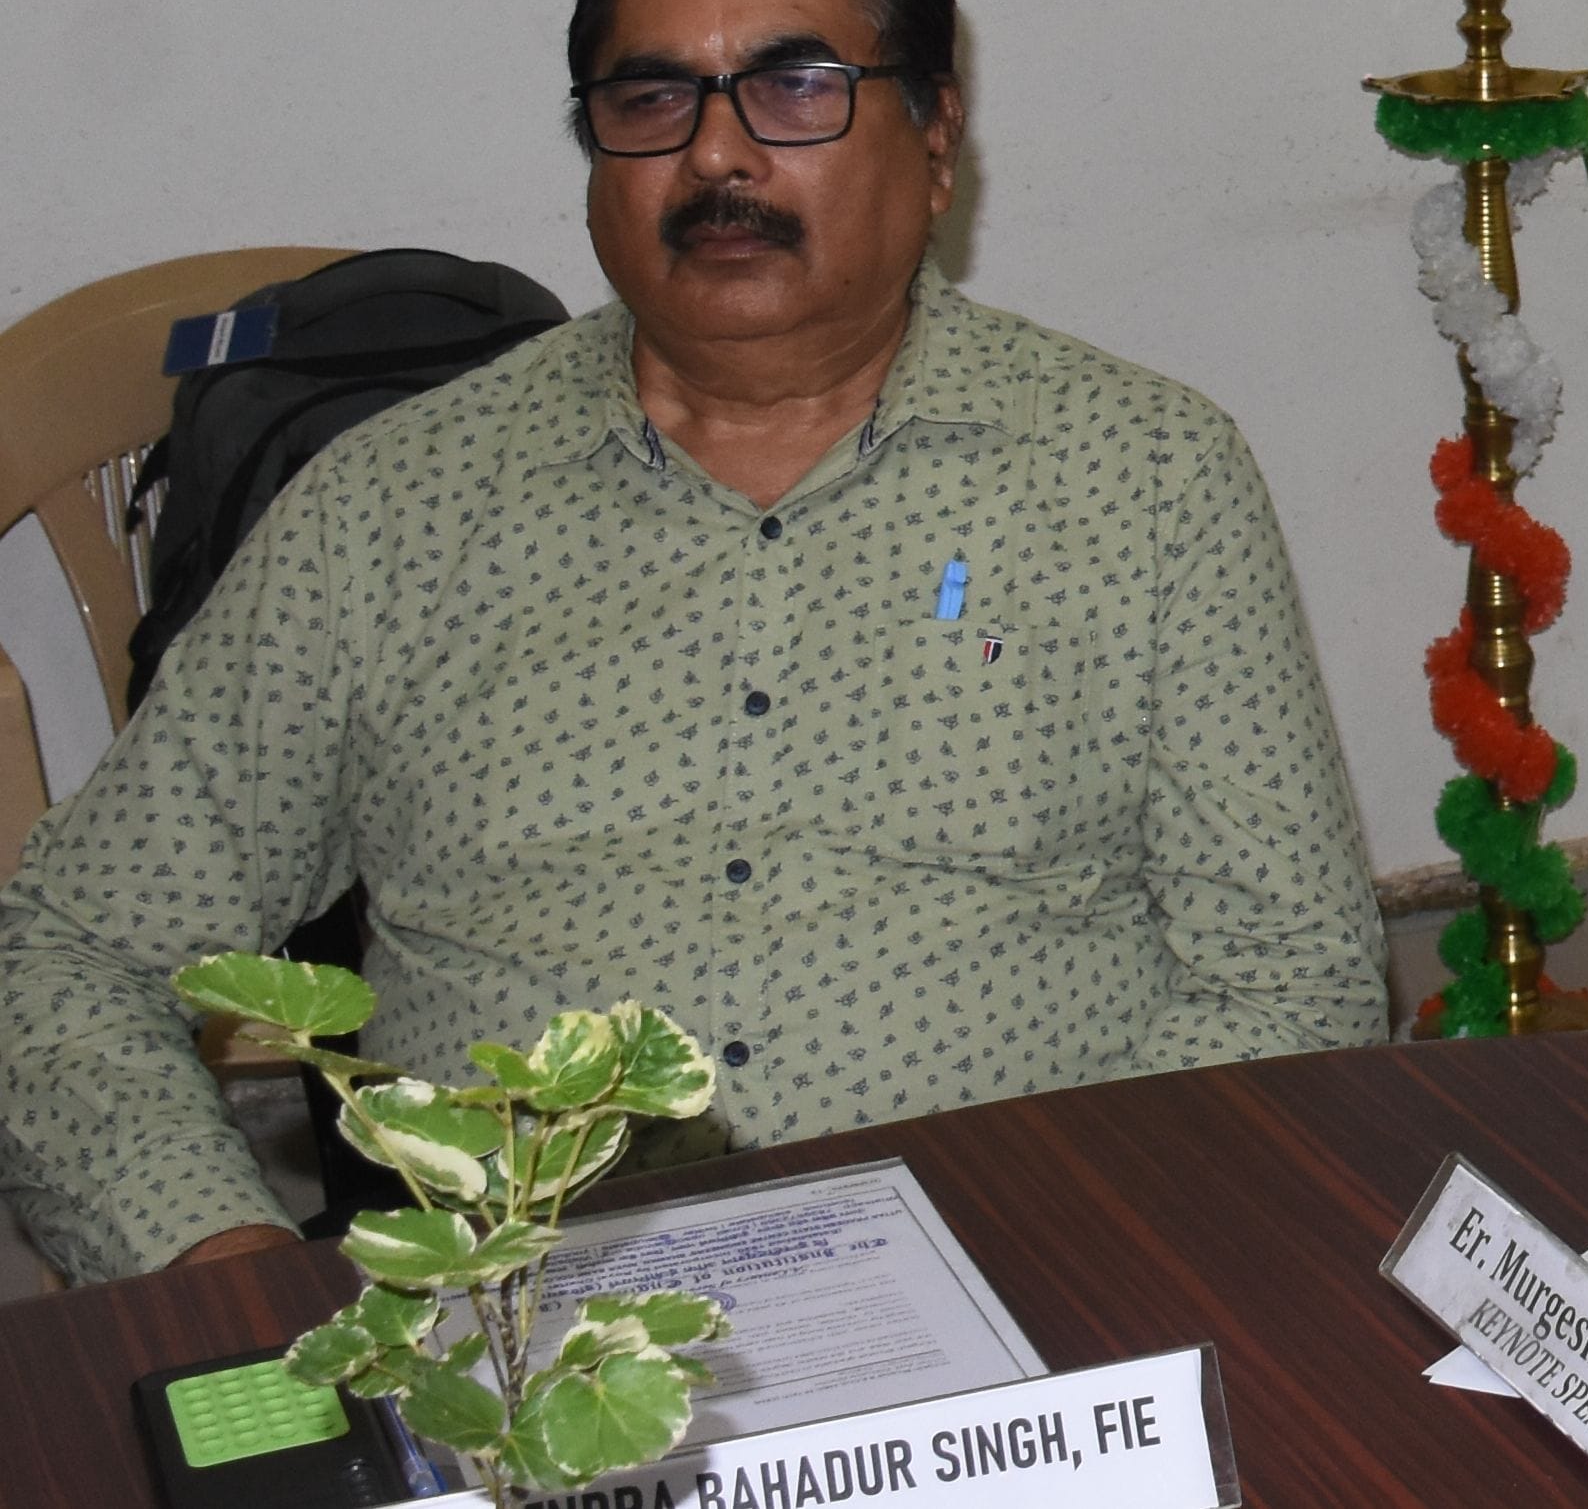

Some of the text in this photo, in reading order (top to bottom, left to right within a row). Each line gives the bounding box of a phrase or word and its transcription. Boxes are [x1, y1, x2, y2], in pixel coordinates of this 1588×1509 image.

[1448, 1205, 1493, 1270] Er.
[1467, 1296, 1565, 1388] KEYNOTE
[695, 1438, 917, 1509] BAHADUR
[930, 1410, 1085, 1484] SINGH,
[1094, 1396, 1162, 1458] FIE
